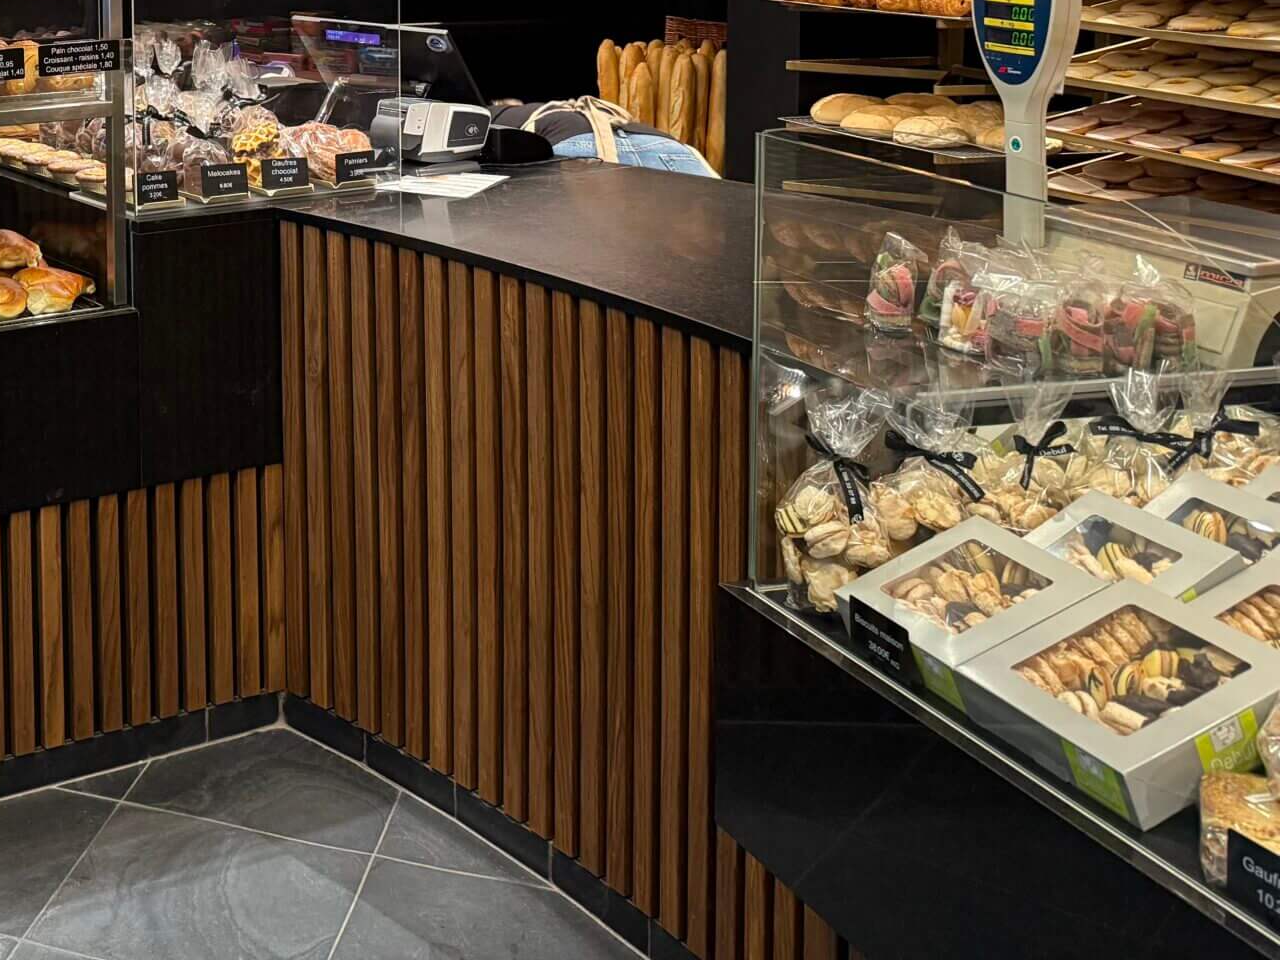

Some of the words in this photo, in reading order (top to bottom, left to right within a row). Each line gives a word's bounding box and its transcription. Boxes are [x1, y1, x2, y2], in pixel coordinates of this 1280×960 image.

[67, 45, 93, 53] chocolat
[44, 56, 74, 64] Croissant
[46, 65, 70, 73] Couque
[344, 157, 368, 166] Palmiers
[272, 167, 298, 175] chocolat
[142, 183, 168, 191] pommes
